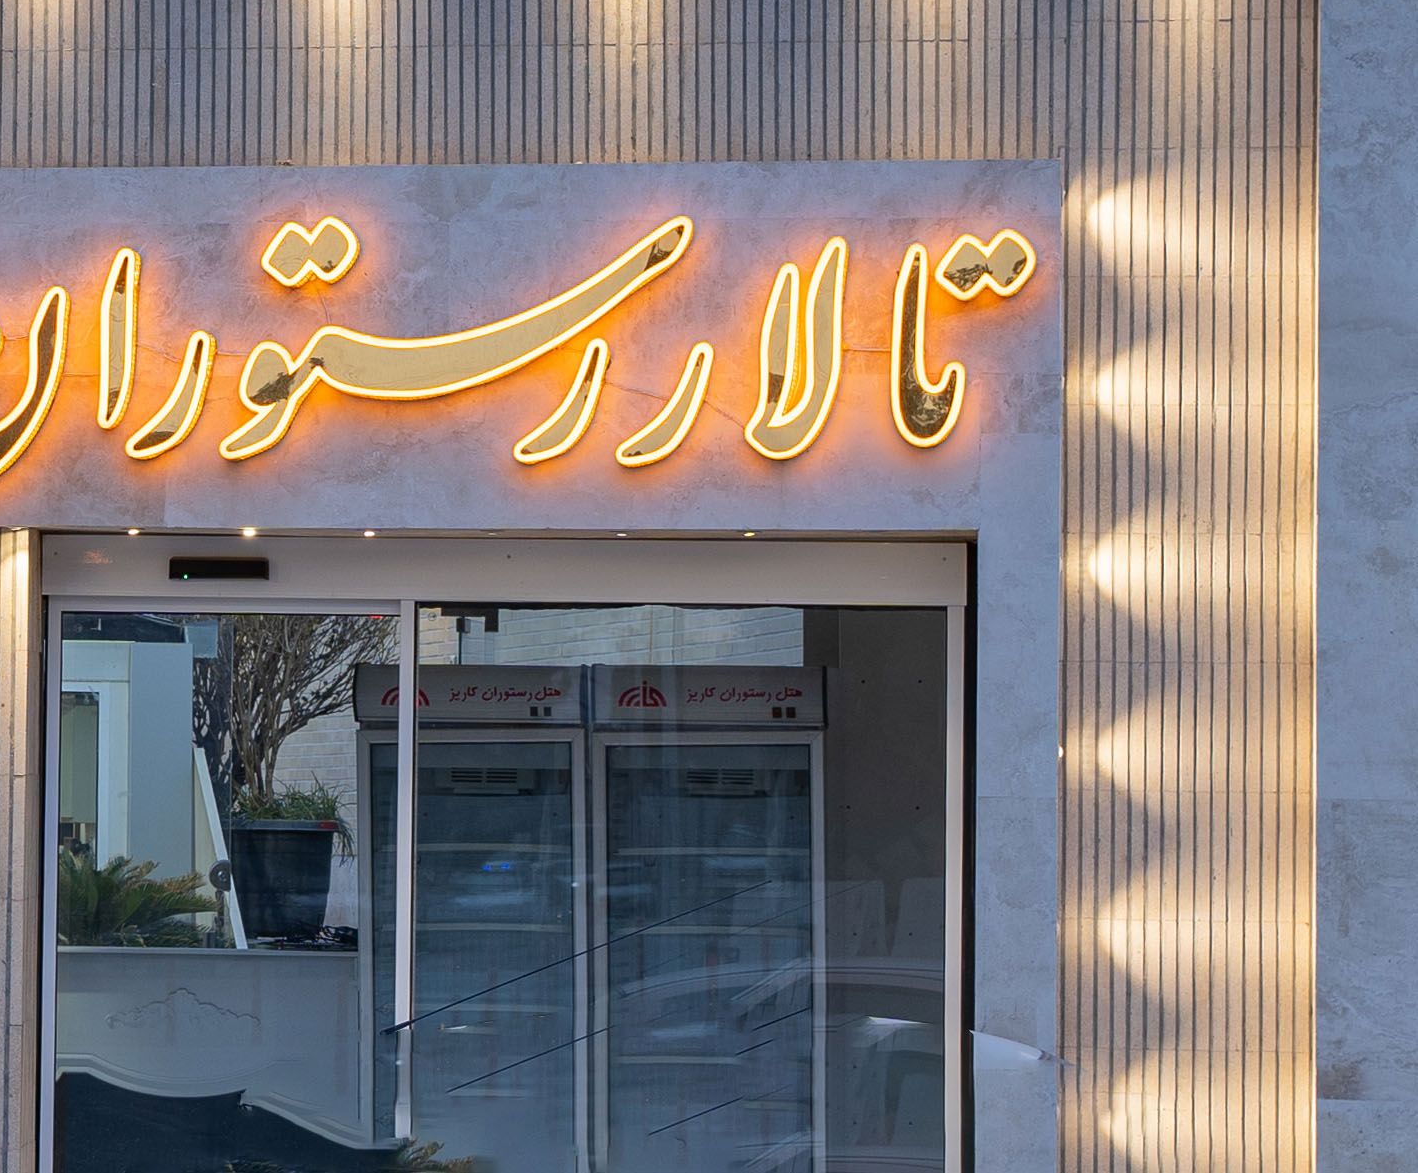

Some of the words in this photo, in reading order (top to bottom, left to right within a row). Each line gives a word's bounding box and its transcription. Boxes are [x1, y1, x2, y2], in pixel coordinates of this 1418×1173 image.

[616, 228, 1038, 469] تالار
[448, 686, 478, 702] کاریز
[482, 686, 533, 702] رستوران
[534, 686, 562, 701] هتل
[685, 686, 716, 703] کاریز
[720, 687, 772, 703] رستوران
[775, 686, 803, 701] هتل
